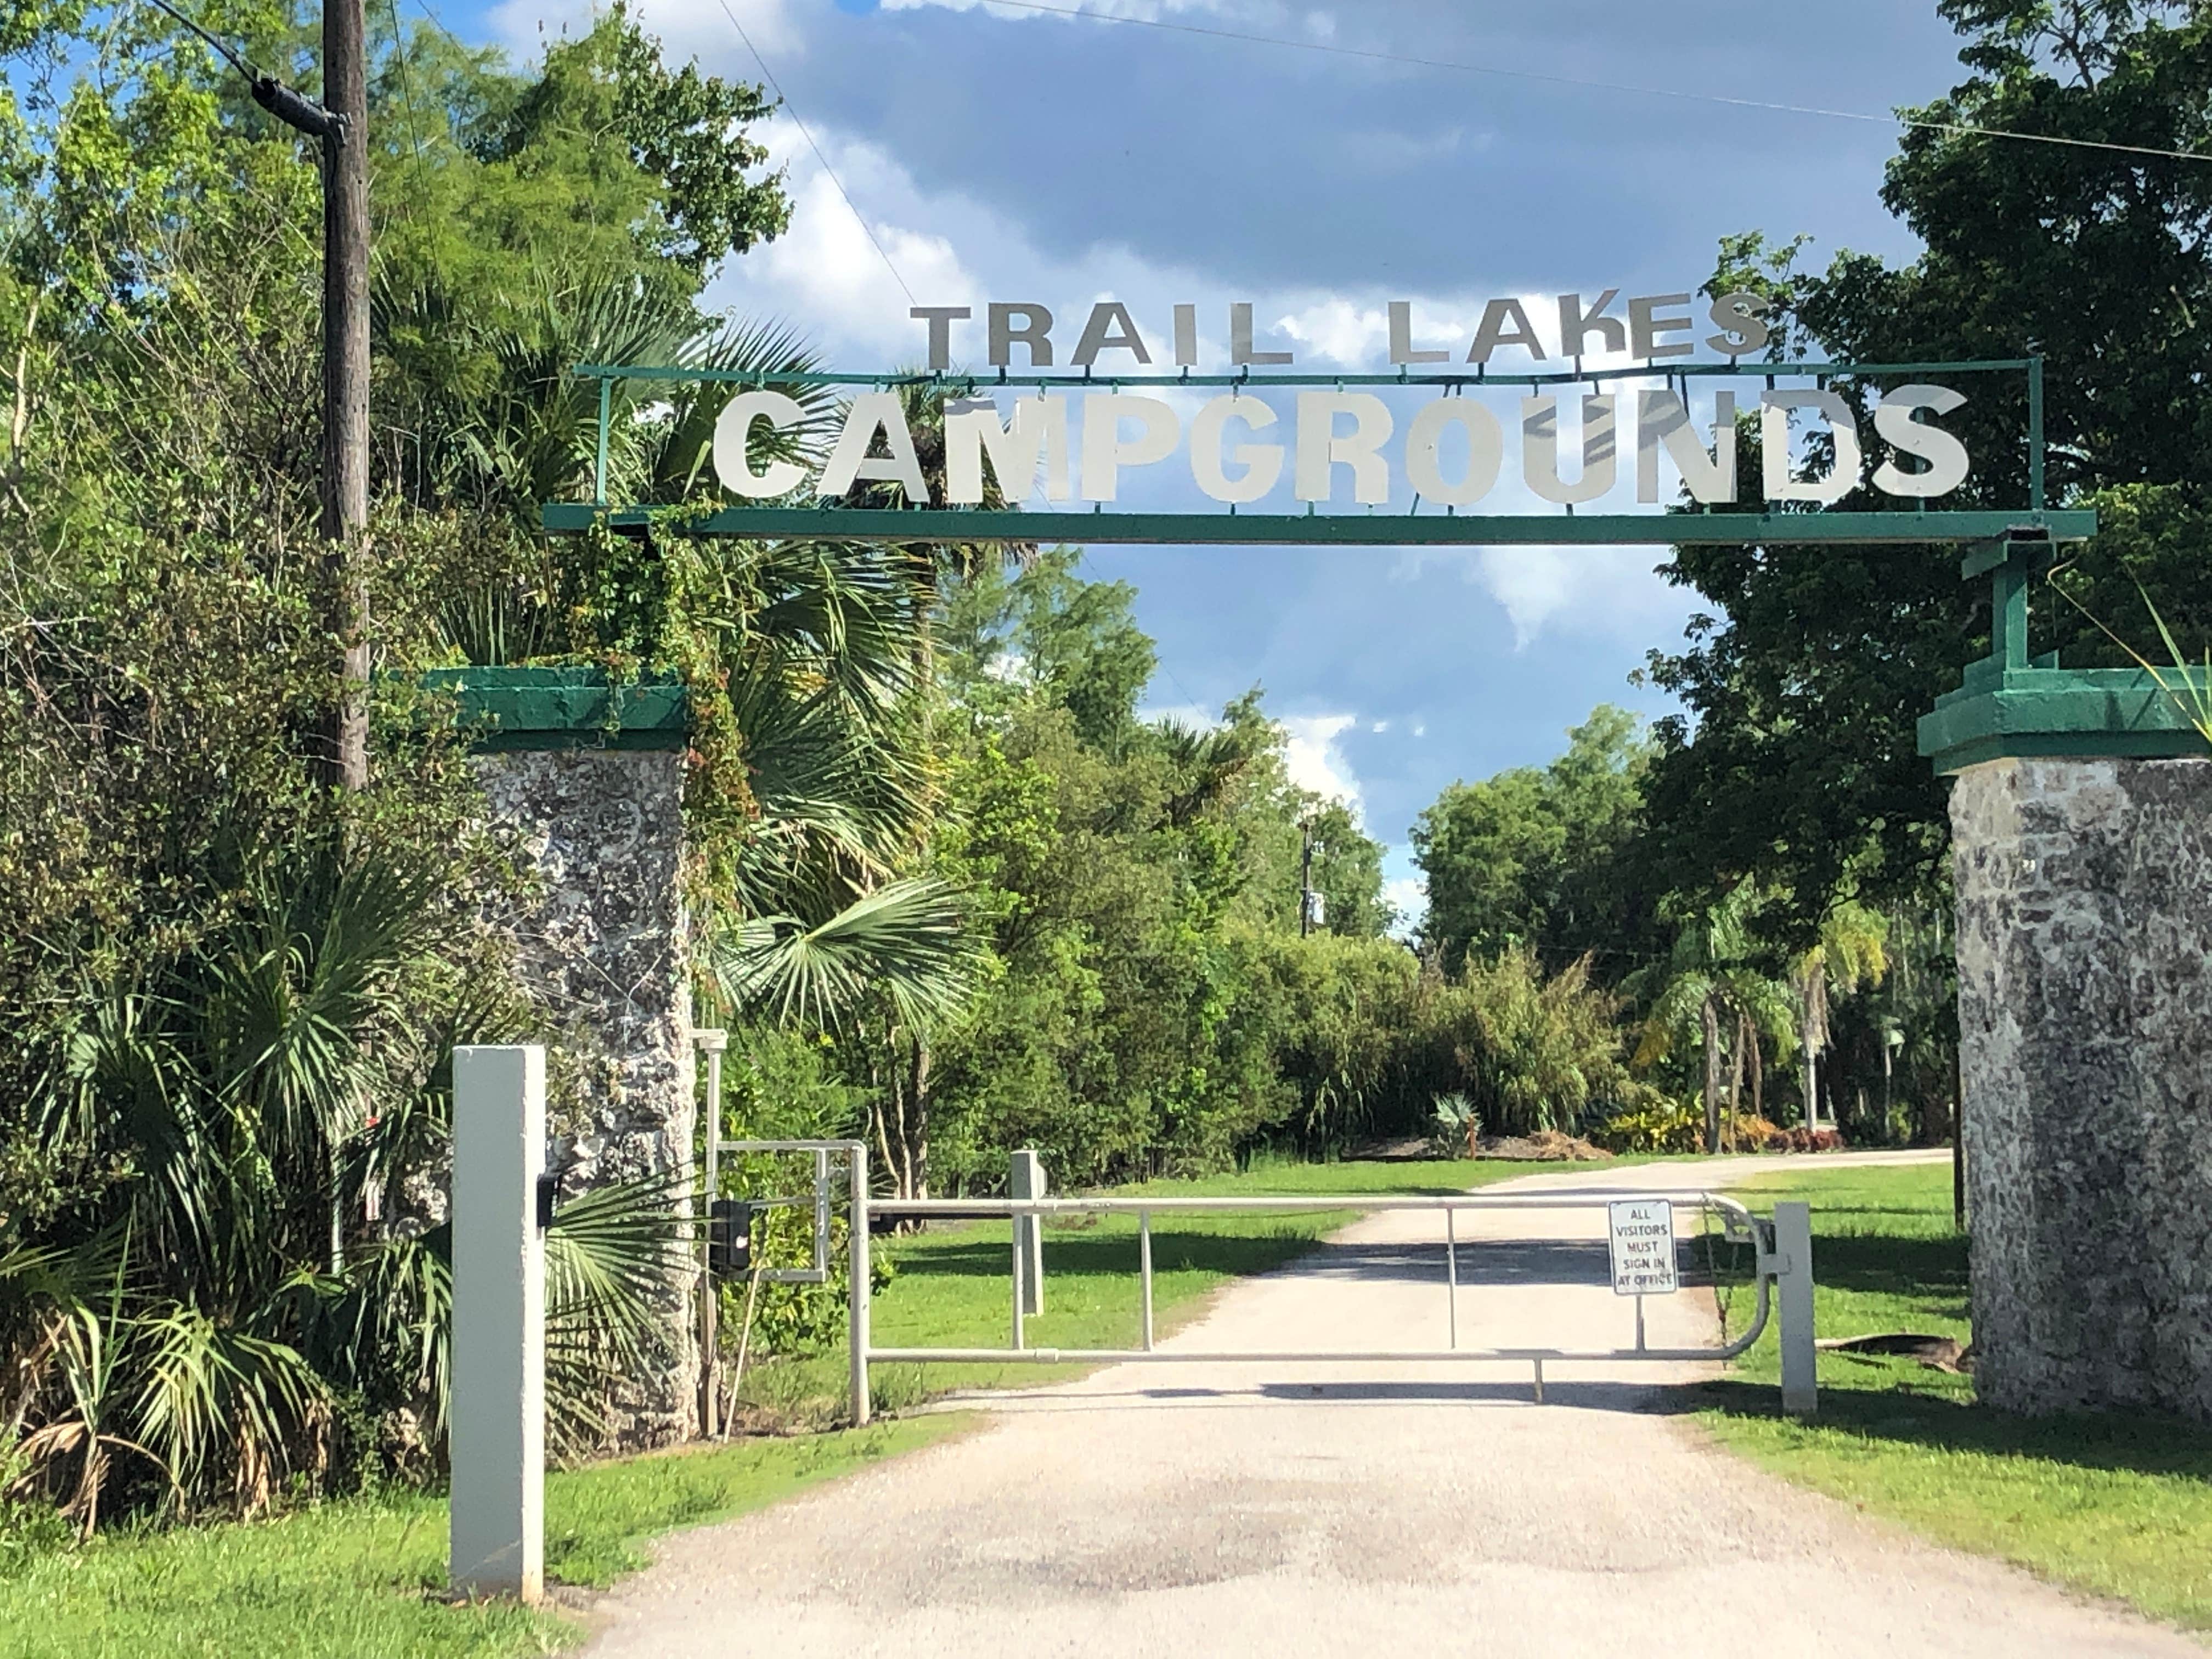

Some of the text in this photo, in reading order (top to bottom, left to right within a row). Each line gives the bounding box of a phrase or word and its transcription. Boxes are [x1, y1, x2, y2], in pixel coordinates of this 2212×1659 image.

[910, 289, 1768, 370] TRAIL LAKES
[713, 384, 1970, 504] CAMPGROUNDS
[1631, 1209, 1650, 1220] ALL
[1616, 1224, 1668, 1237] VISITORS
[1628, 1241, 1658, 1252] MUST
[1623, 1258, 1665, 1269] SIGN IN
[1618, 1276, 1630, 1286] AT
